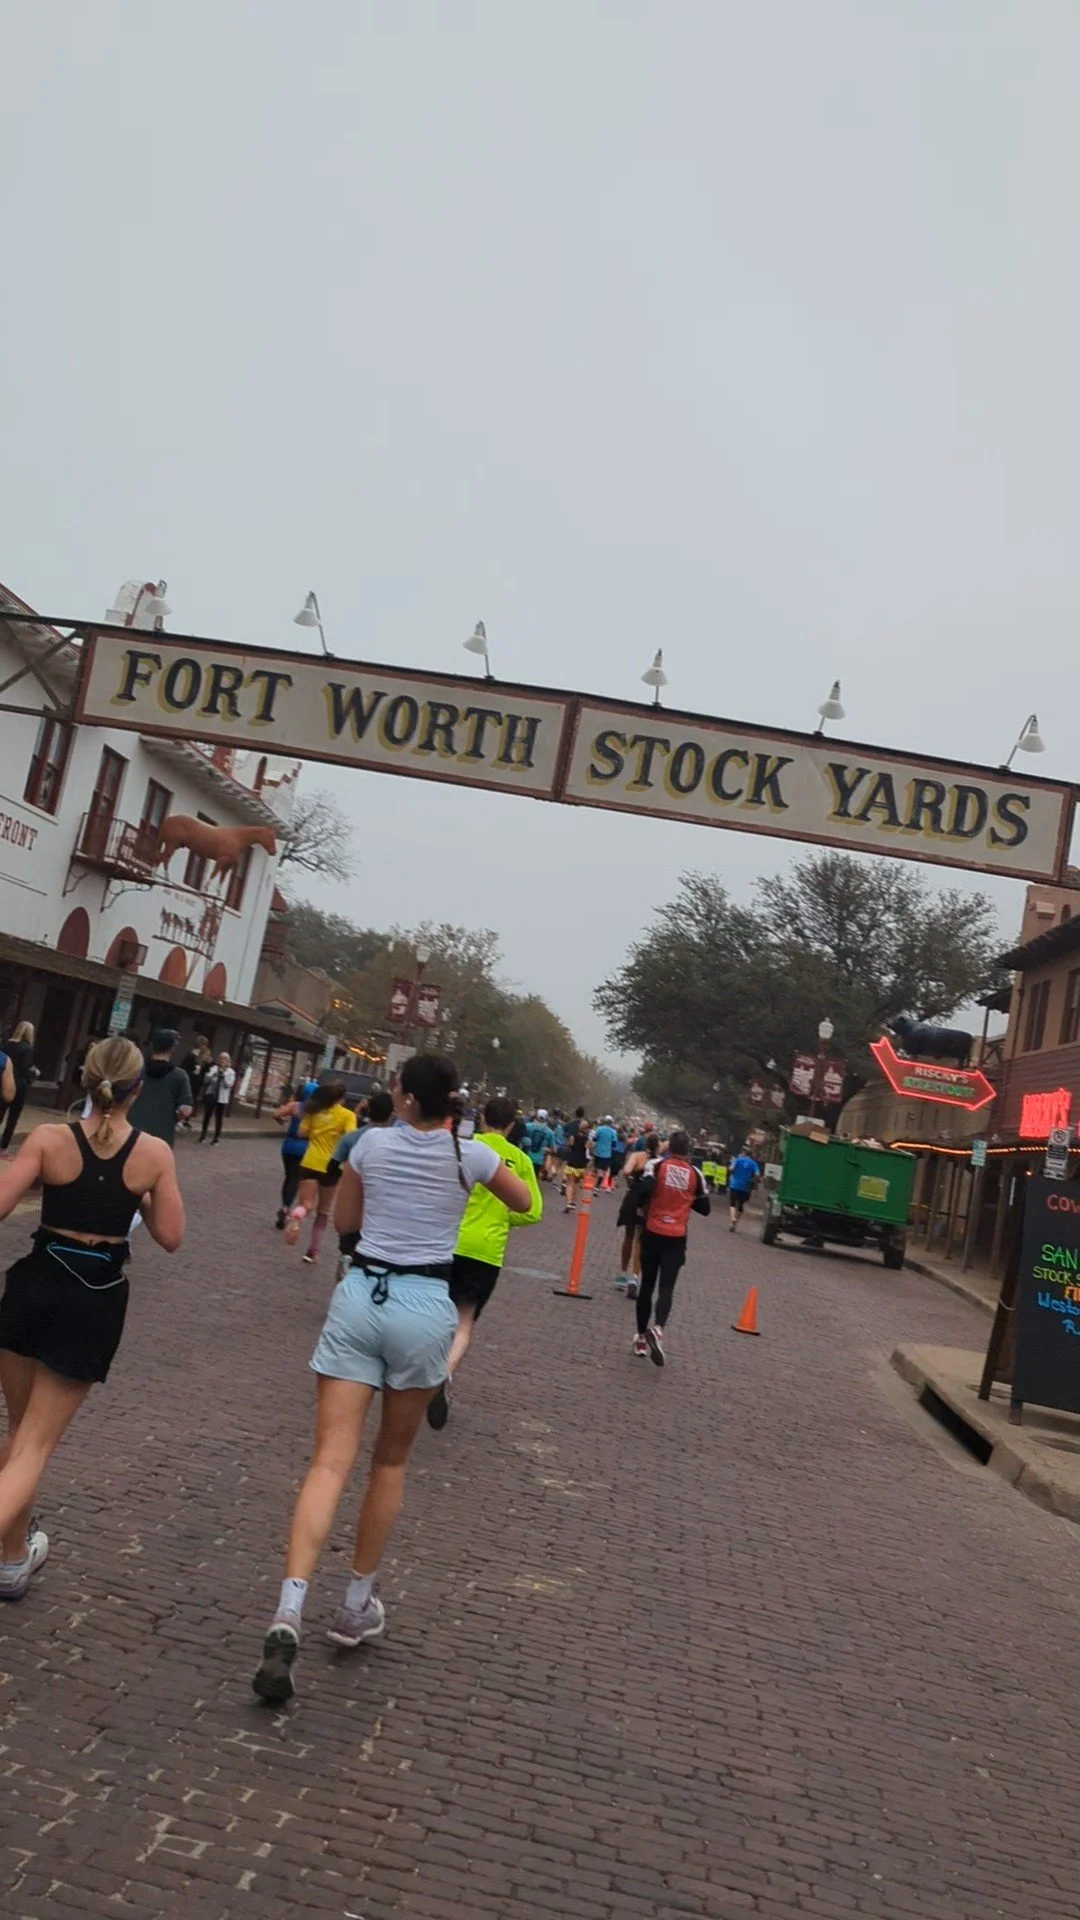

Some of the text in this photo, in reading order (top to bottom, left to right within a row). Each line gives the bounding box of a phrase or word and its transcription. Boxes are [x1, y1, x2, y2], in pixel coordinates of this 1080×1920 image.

[112, 650, 1031, 850] FORT WORTH STOCK YARDS
[1041, 1243, 1078, 1269] SAN
[1032, 1265, 1073, 1285] STOCK
